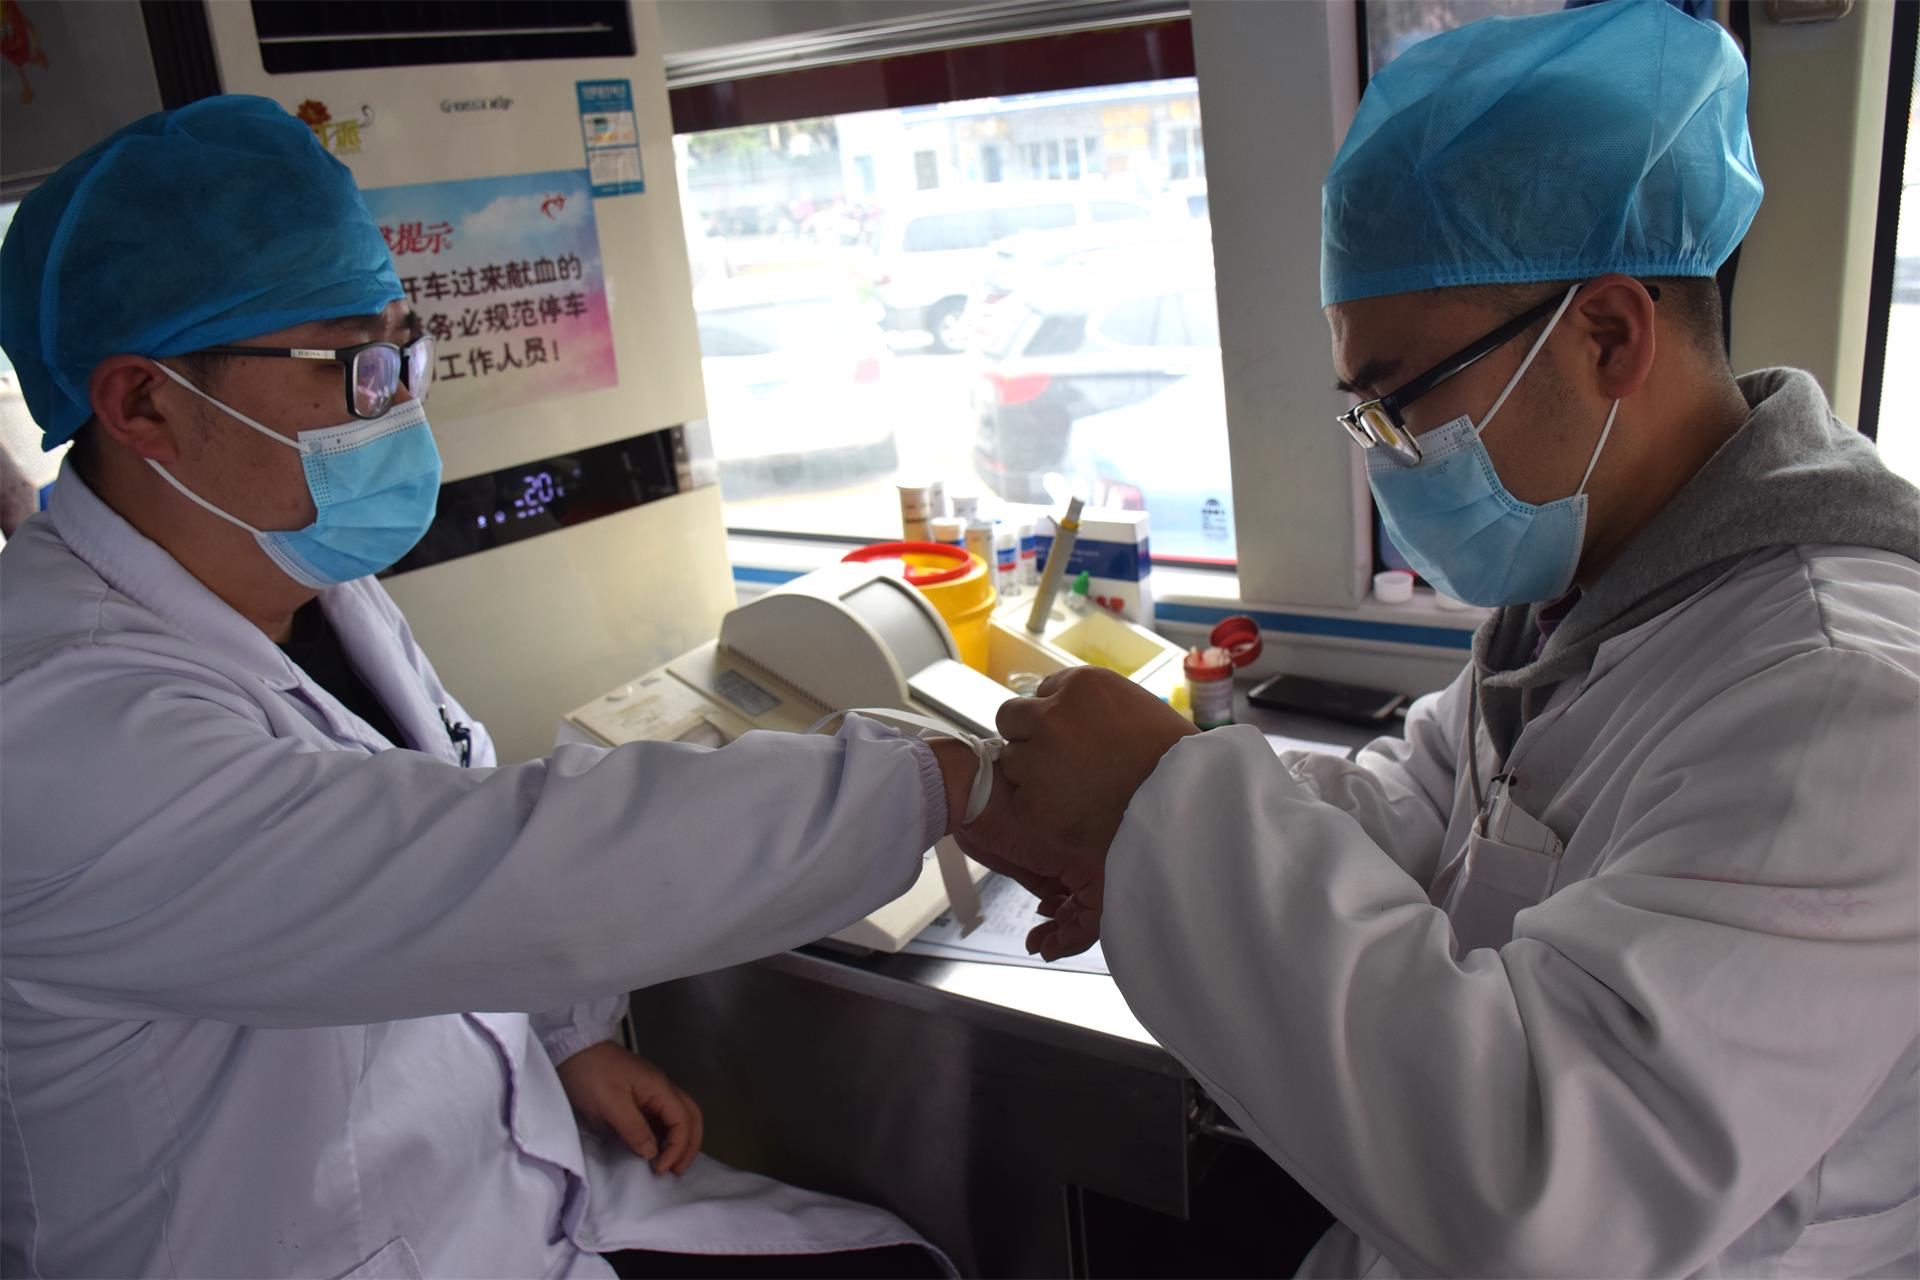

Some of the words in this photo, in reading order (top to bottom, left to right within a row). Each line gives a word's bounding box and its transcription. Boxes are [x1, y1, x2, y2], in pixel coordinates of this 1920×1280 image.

[432, 336, 559, 382] 工作人员！
[523, 471, 554, 507] 20
